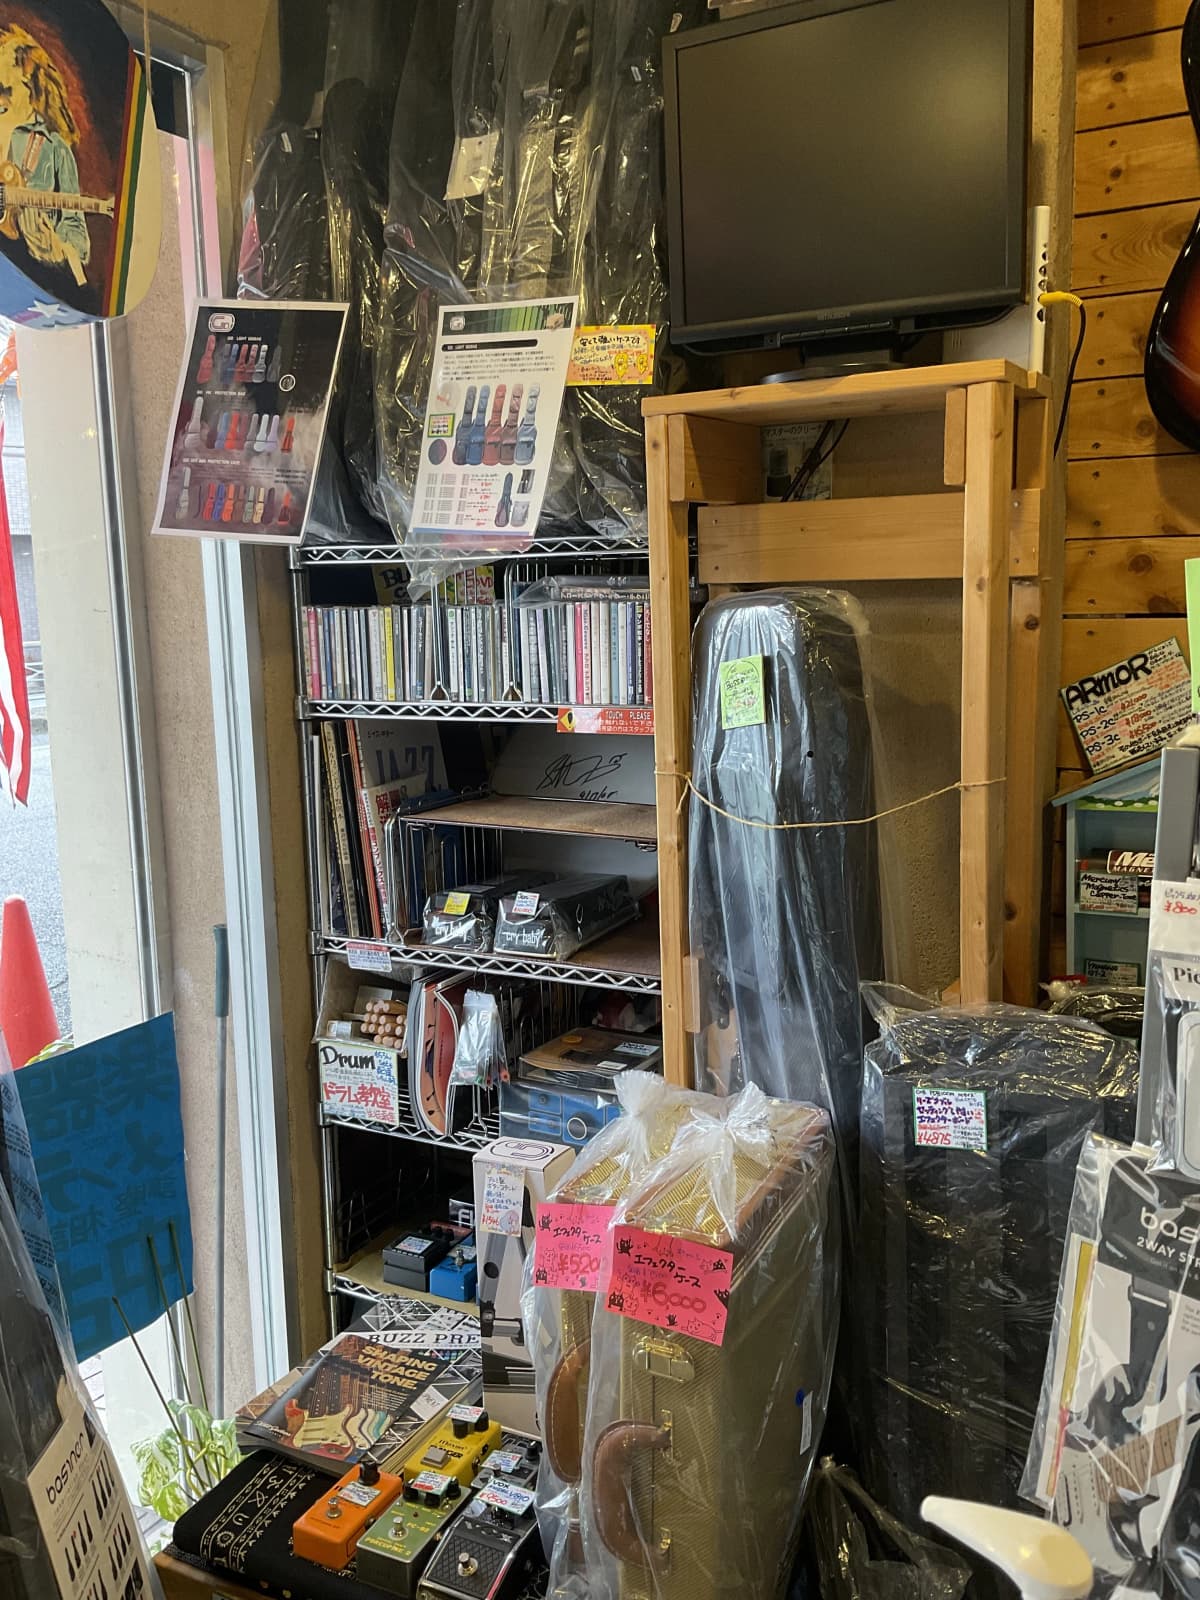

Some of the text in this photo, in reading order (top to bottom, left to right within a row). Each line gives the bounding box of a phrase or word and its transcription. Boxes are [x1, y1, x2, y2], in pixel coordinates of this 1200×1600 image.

[629, 711, 651, 720] PLEASE
[320, 1046, 376, 1069] Drum
[1136, 1236, 1176, 1258] 2WAY
[368, 1333, 426, 1344] BUZZ
[358, 1355, 431, 1380] VINTAGE
[361, 1345, 438, 1371] SHAPING
